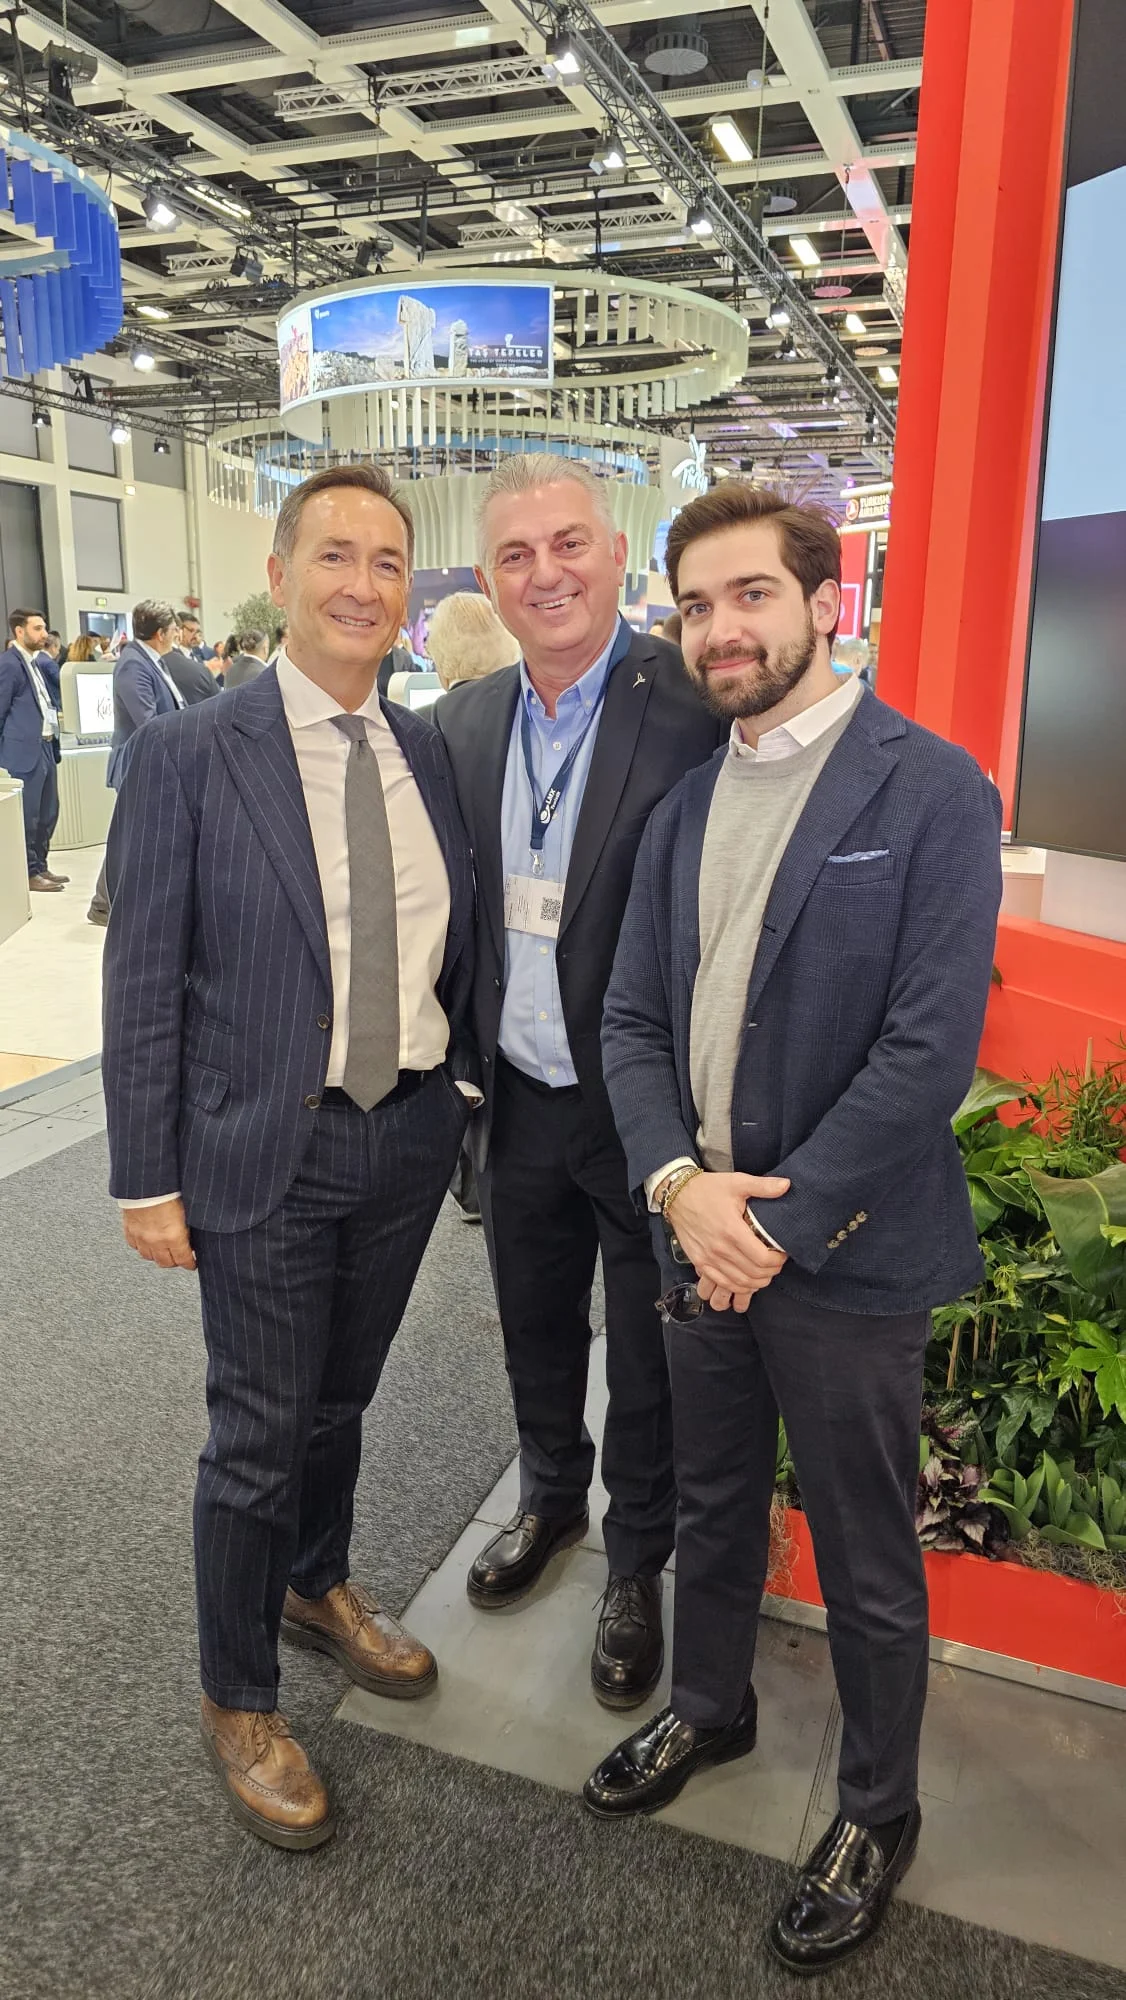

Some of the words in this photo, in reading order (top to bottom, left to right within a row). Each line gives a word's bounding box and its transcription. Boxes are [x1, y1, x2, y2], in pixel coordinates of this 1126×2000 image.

[494, 348, 544, 358] TEPELER
[860, 494, 891, 508] TURKISH
[858, 504, 889, 518] AIRLINES
